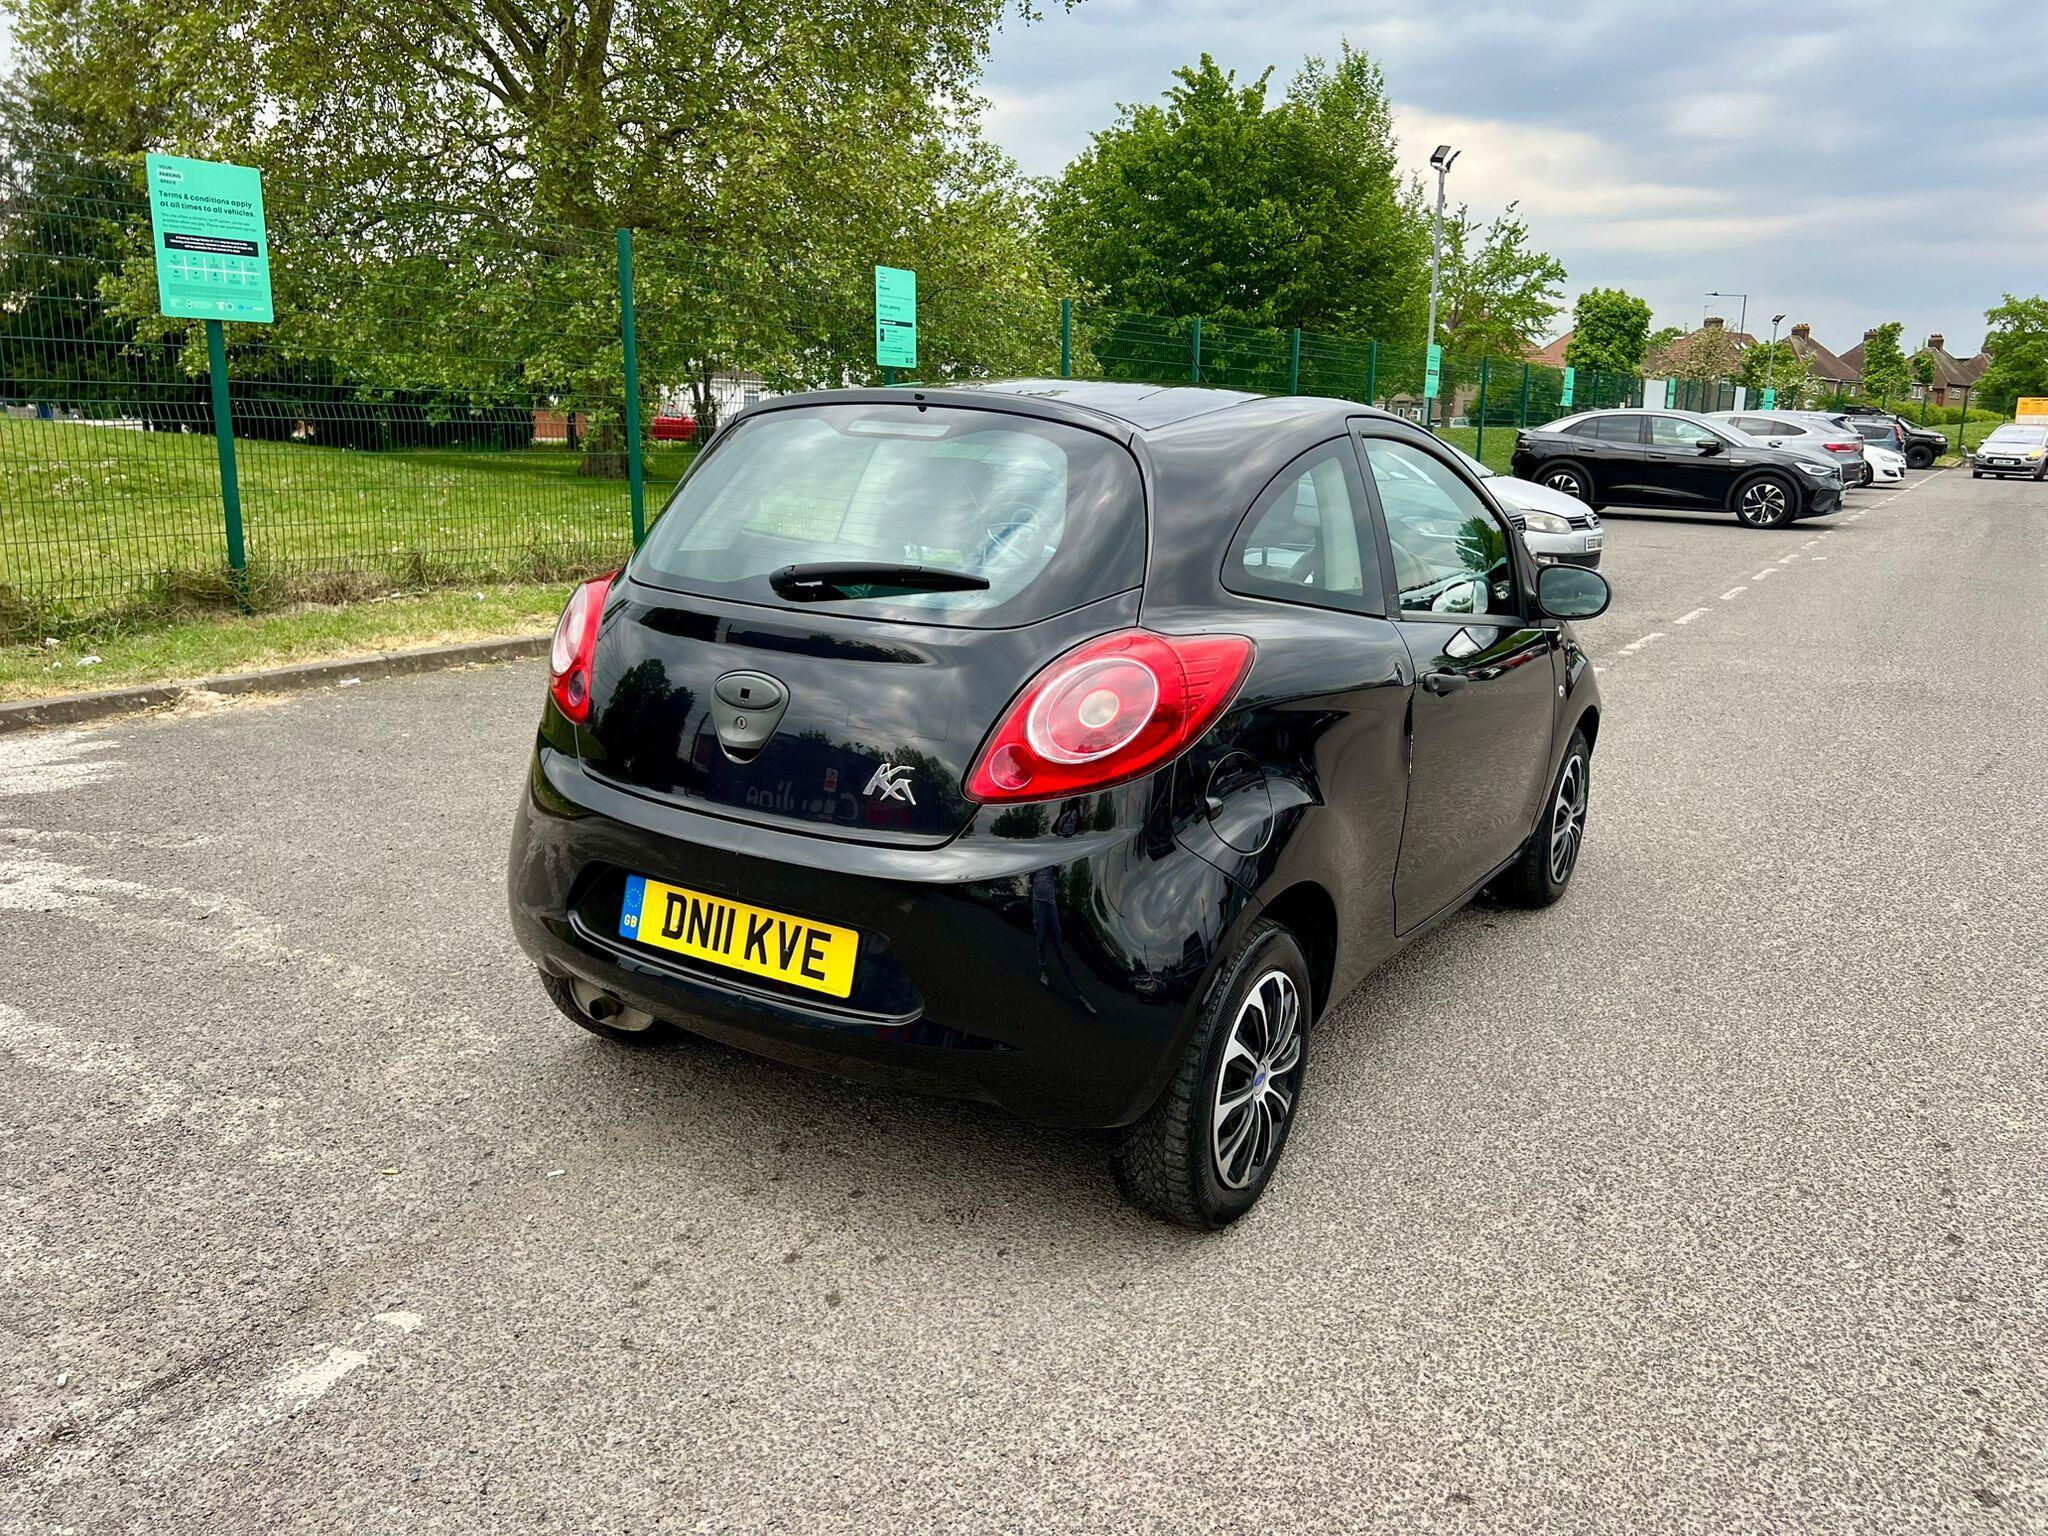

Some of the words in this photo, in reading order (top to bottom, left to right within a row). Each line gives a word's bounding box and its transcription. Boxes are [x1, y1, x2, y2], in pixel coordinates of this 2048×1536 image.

[159, 190, 182, 199] Terms
[189, 195, 229, 205] conditions
[230, 199, 251, 209] apply
[170, 200, 180, 208] all
[181, 202, 202, 211] times
[223, 207, 255, 217] vehicles.
[624, 913, 637, 928] GB
[744, 913, 832, 982] KVE
